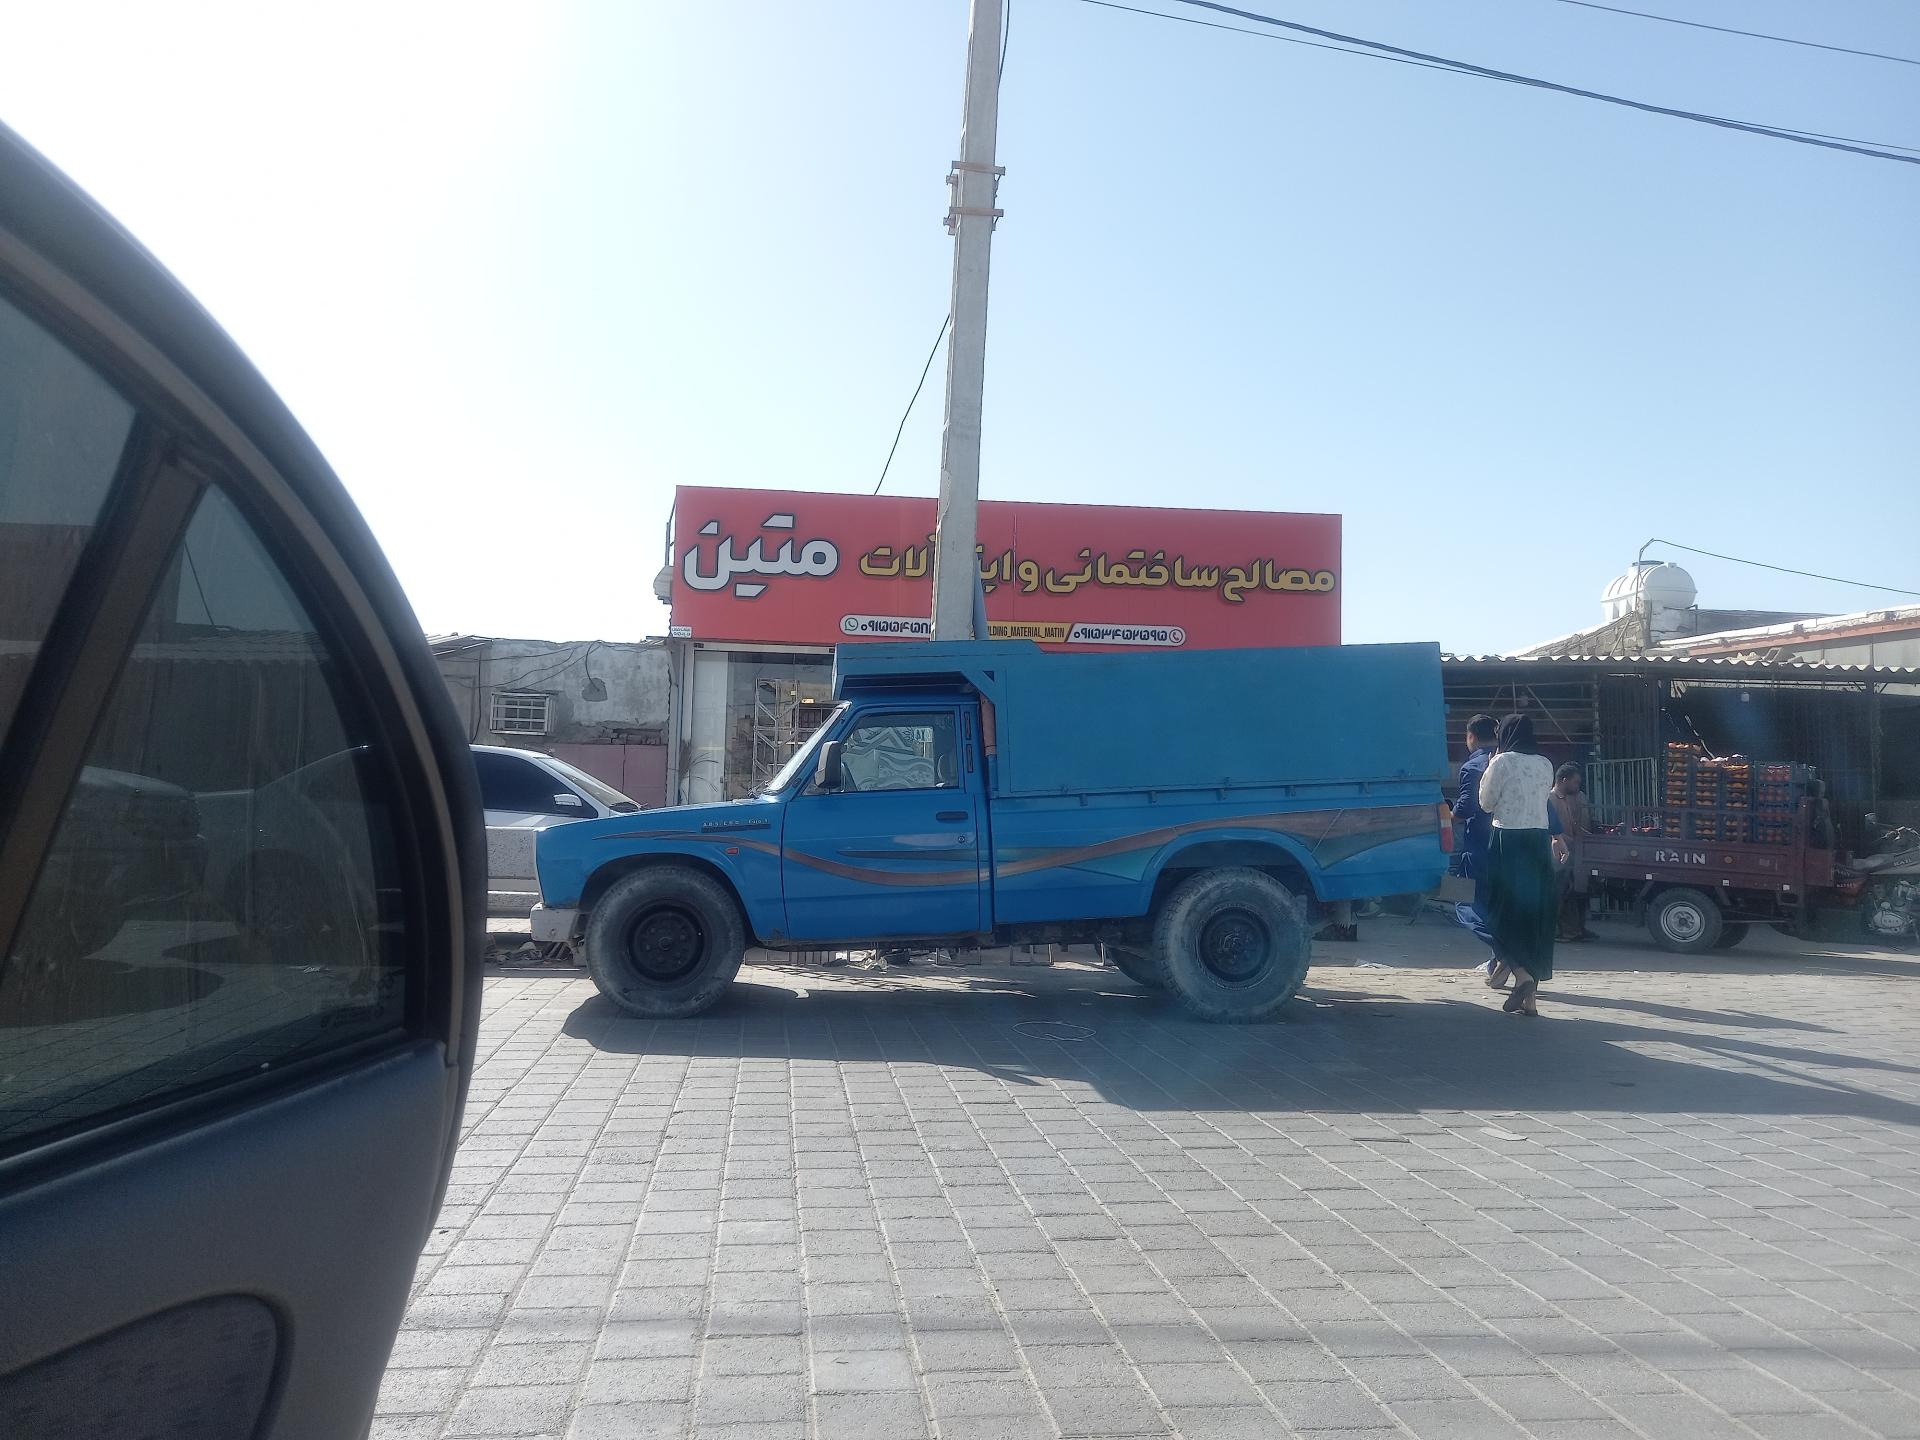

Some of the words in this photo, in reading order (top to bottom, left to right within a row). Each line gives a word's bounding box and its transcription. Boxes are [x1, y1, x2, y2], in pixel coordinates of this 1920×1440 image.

[682, 513, 839, 598] متین
[1221, 558, 1337, 602] مصالح
[1655, 850, 1706, 865] RAIN
